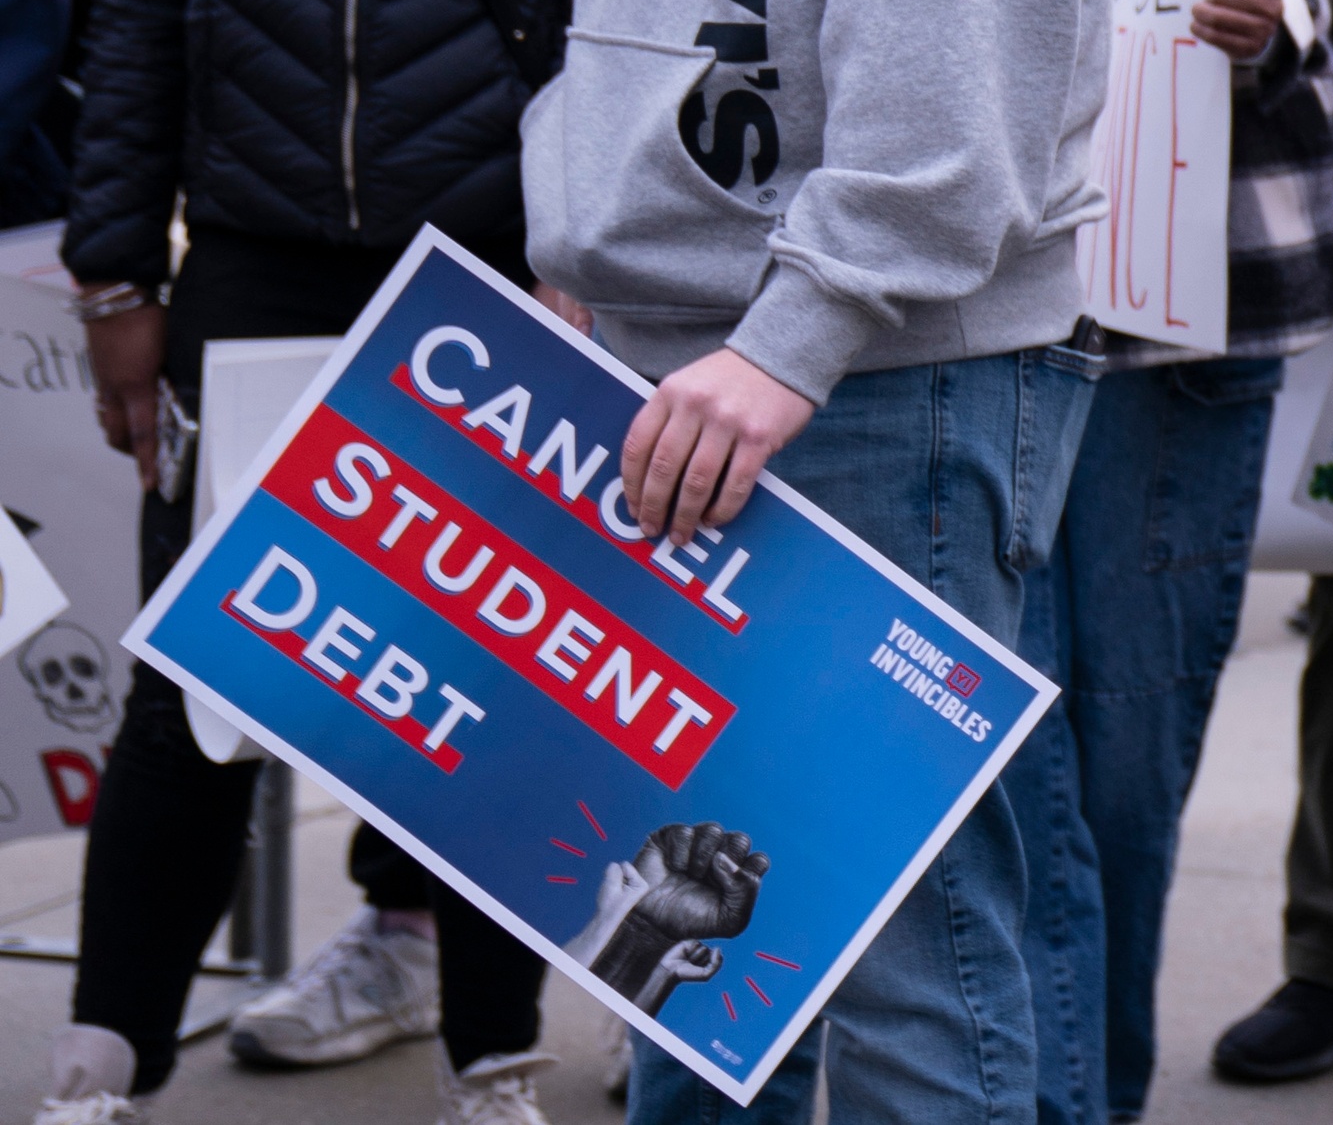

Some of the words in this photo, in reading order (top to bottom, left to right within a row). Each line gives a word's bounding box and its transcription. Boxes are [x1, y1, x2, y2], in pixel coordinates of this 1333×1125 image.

[410, 324, 751, 625] CANCEL
[230, 543, 487, 754] DEBT
[312, 442, 714, 757] STUDENT
[869, 642, 993, 743] INVINCIBLES
[886, 617, 954, 681] YOUNG
